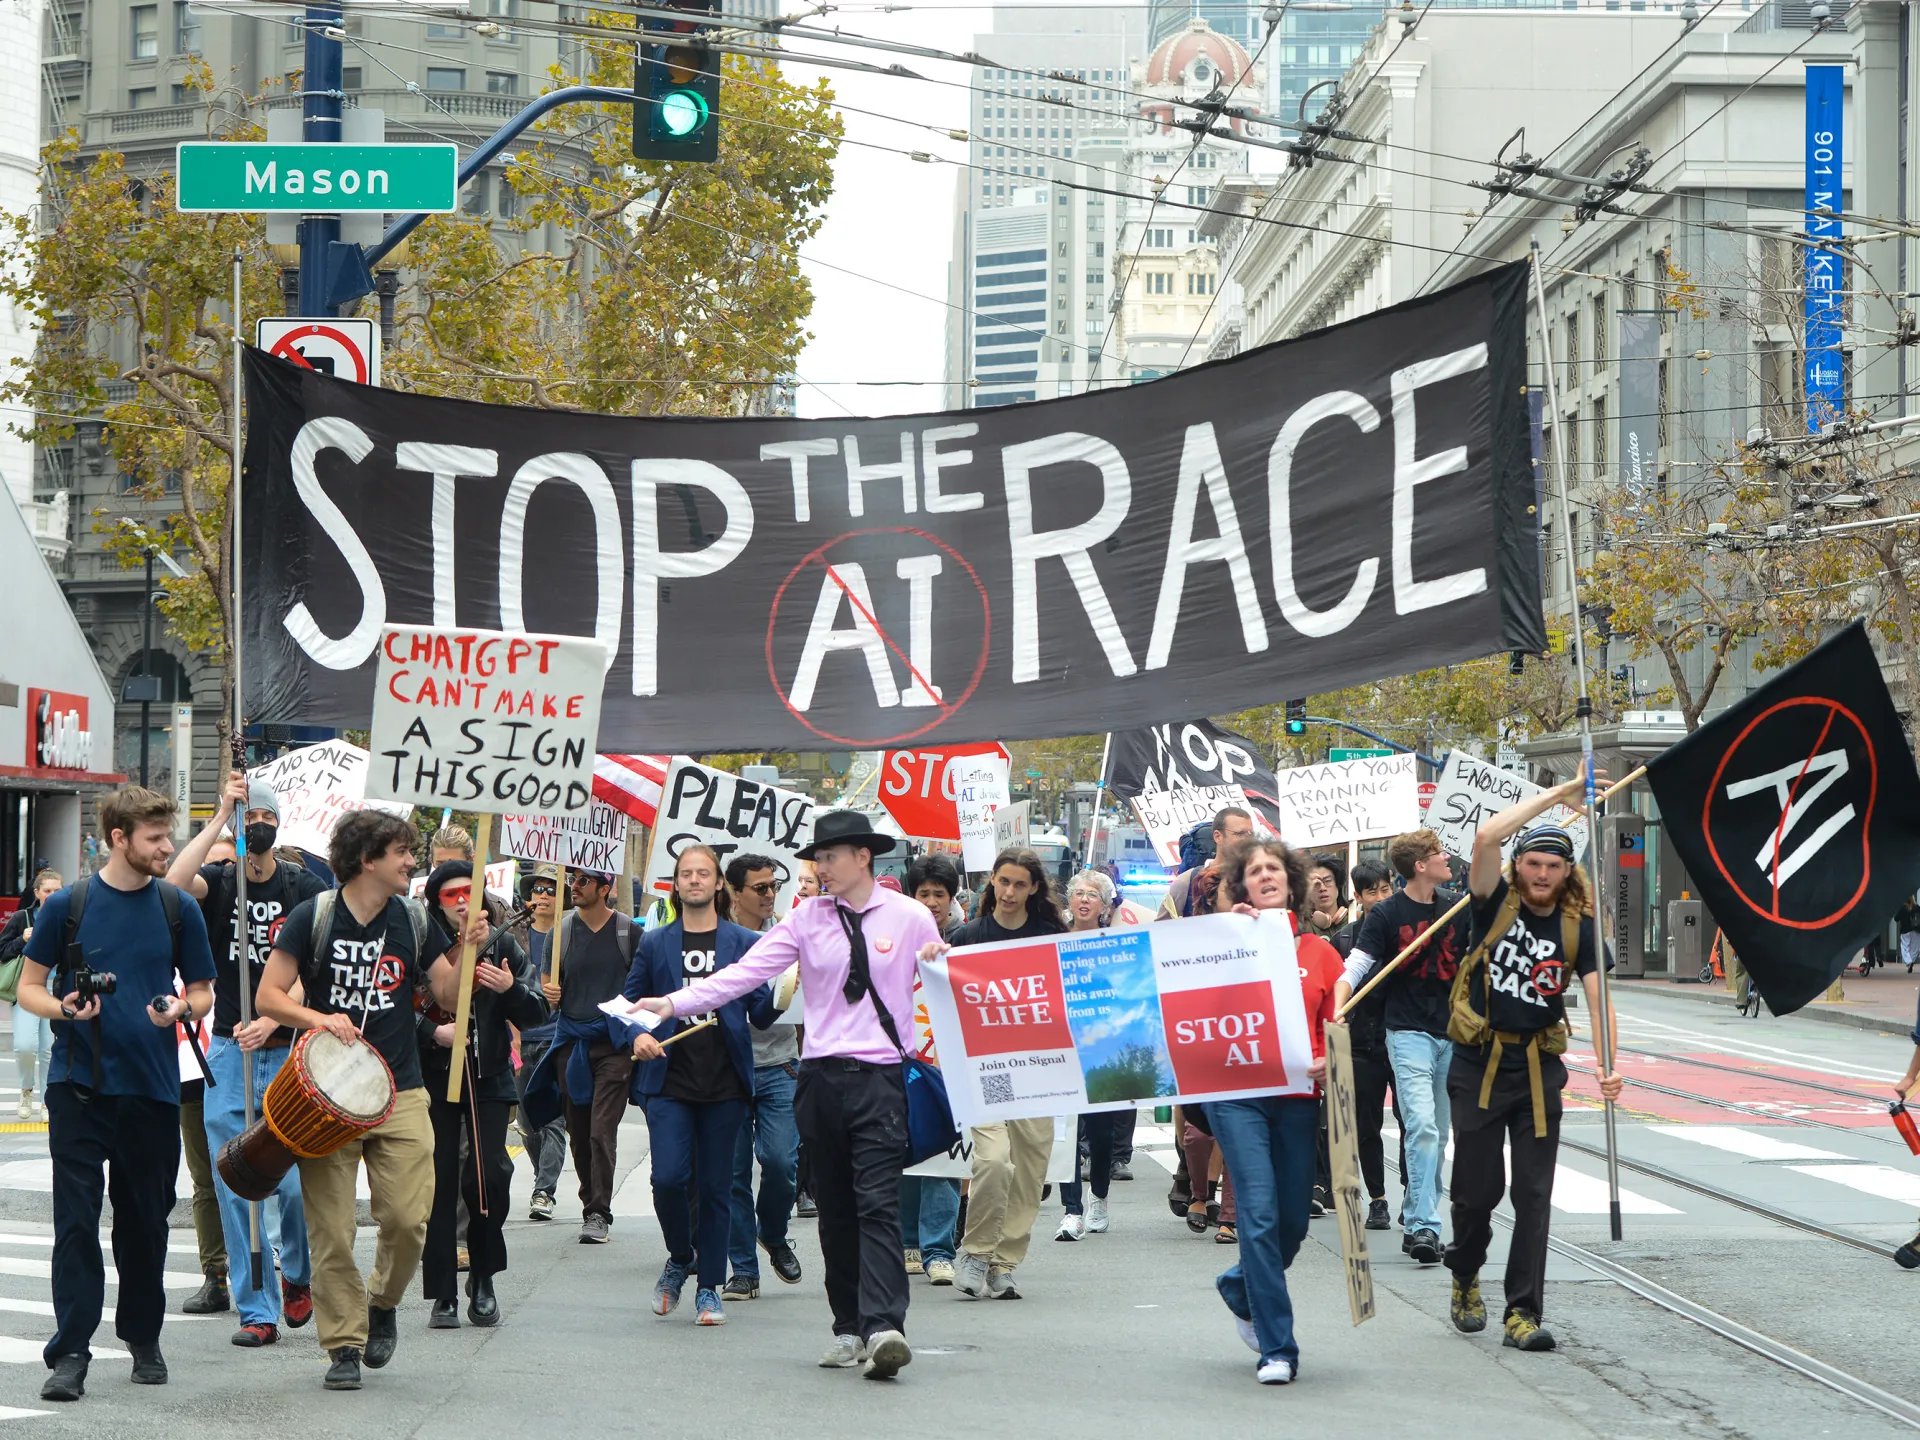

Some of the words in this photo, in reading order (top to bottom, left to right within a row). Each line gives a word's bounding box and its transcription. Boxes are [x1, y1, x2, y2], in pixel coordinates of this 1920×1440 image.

[1814, 131, 1833, 175] 901
[245, 159, 390, 195] Mason
[282, 415, 755, 696] STOP
[759, 421, 986, 523] THE
[1000, 341, 1489, 685] RACE
[789, 553, 943, 712] AI
[384, 631, 560, 677] CHATGPT
[388, 670, 488, 710] CAN'T
[494, 688, 585, 718] MAKE
[401, 715, 432, 749] A
[455, 718, 586, 769] SIGN
[1346, 752, 1361, 760] 5th
[272, 755, 303, 782] NO
[308, 747, 364, 771] ONE
[884, 750, 957, 802] STO
[960, 767, 994, 783] Letting
[1287, 761, 1355, 785] MAY
[1363, 757, 1414, 777] YOUR
[178, 770, 186, 802] Powell
[271, 772, 307, 794] ILDS
[314, 769, 342, 791] IT
[1282, 780, 1394, 807] TRAINING
[1456, 759, 1522, 804] ENOUGH
[667, 765, 814, 850] PLEASE
[1134, 794, 1157, 812] IF
[1170, 784, 1240, 806] ANYONE
[1295, 801, 1367, 819] RUNS
[1144, 801, 1219, 830] BUILDS
[1308, 816, 1387, 838] FAIL
[1725, 748, 1857, 889] AI
[507, 824, 563, 862] WON'T
[569, 835, 619, 872] WORK
[232, 896, 283, 922] SOP
[1619, 875, 1628, 921] POWELL
[228, 941, 272, 965] RAC
[332, 938, 385, 963] STO
[1058, 936, 1118, 954] Billionares
[1120, 934, 1139, 947] are
[1619, 925, 1628, 966] STREET
[1062, 956, 1096, 971] trying
[1098, 954, 1110, 965] to
[1112, 951, 1136, 963] take
[1161, 948, 1259, 969] www.stopai.live
[961, 974, 1049, 1005] SAVE
[1064, 974, 1079, 986] all
[1080, 971, 1093, 984] of
[329, 984, 396, 1012] RACE
[1066, 989, 1088, 1002] this
[977, 1001, 1053, 1027] LIFE
[1068, 1005, 1096, 1018] from
[1097, 1005, 1111, 1016] us
[1174, 1011, 1266, 1045] STOP
[979, 1059, 1006, 1072] Join
[1008, 1058, 1026, 1068] On
[1028, 1054, 1066, 1067] Signal
[1224, 1040, 1264, 1067] AI
